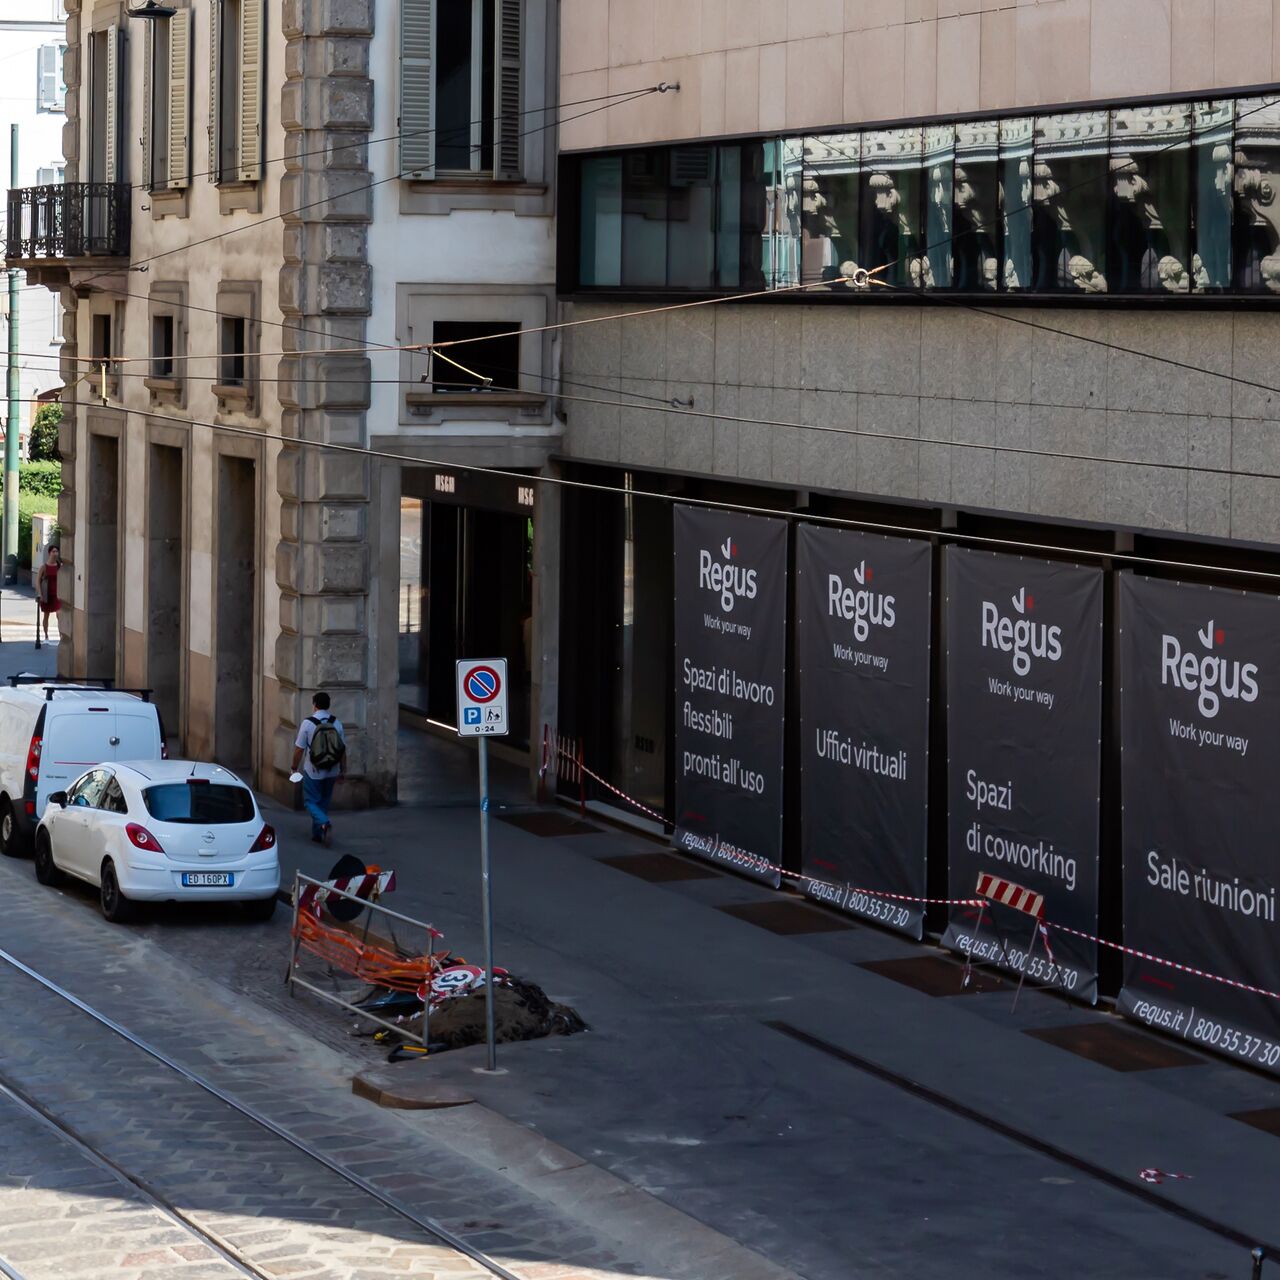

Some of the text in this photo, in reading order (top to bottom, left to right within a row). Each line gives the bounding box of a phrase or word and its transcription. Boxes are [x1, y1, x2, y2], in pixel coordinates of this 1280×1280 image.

[435, 474, 455, 493] MSGM
[699, 549, 758, 612] Regus
[704, 613, 752, 640] Work your way
[828, 573, 896, 642] Regus
[833, 643, 889, 672] Work your way
[982, 601, 1062, 676] Regus
[683, 658, 775, 706] Spazi di lavoro
[989, 677, 1055, 710] Work your way
[1161, 634, 1259, 718] Regus
[683, 701, 733, 740] flessibili
[1169, 718, 1249, 756] Work your way
[683, 751, 765, 794] pronti all'uso
[816, 728, 907, 780] Uffici virtuali
[966, 769, 1012, 811] Spazi
[681, 831, 714, 853] regus.it
[966, 822, 1076, 891] di coworking
[188, 873, 199, 885] ED
[807, 879, 842, 903] regus.it
[1147, 851, 1275, 922] Sale riunioni
[1132, 1000, 1184, 1031] regus.it
